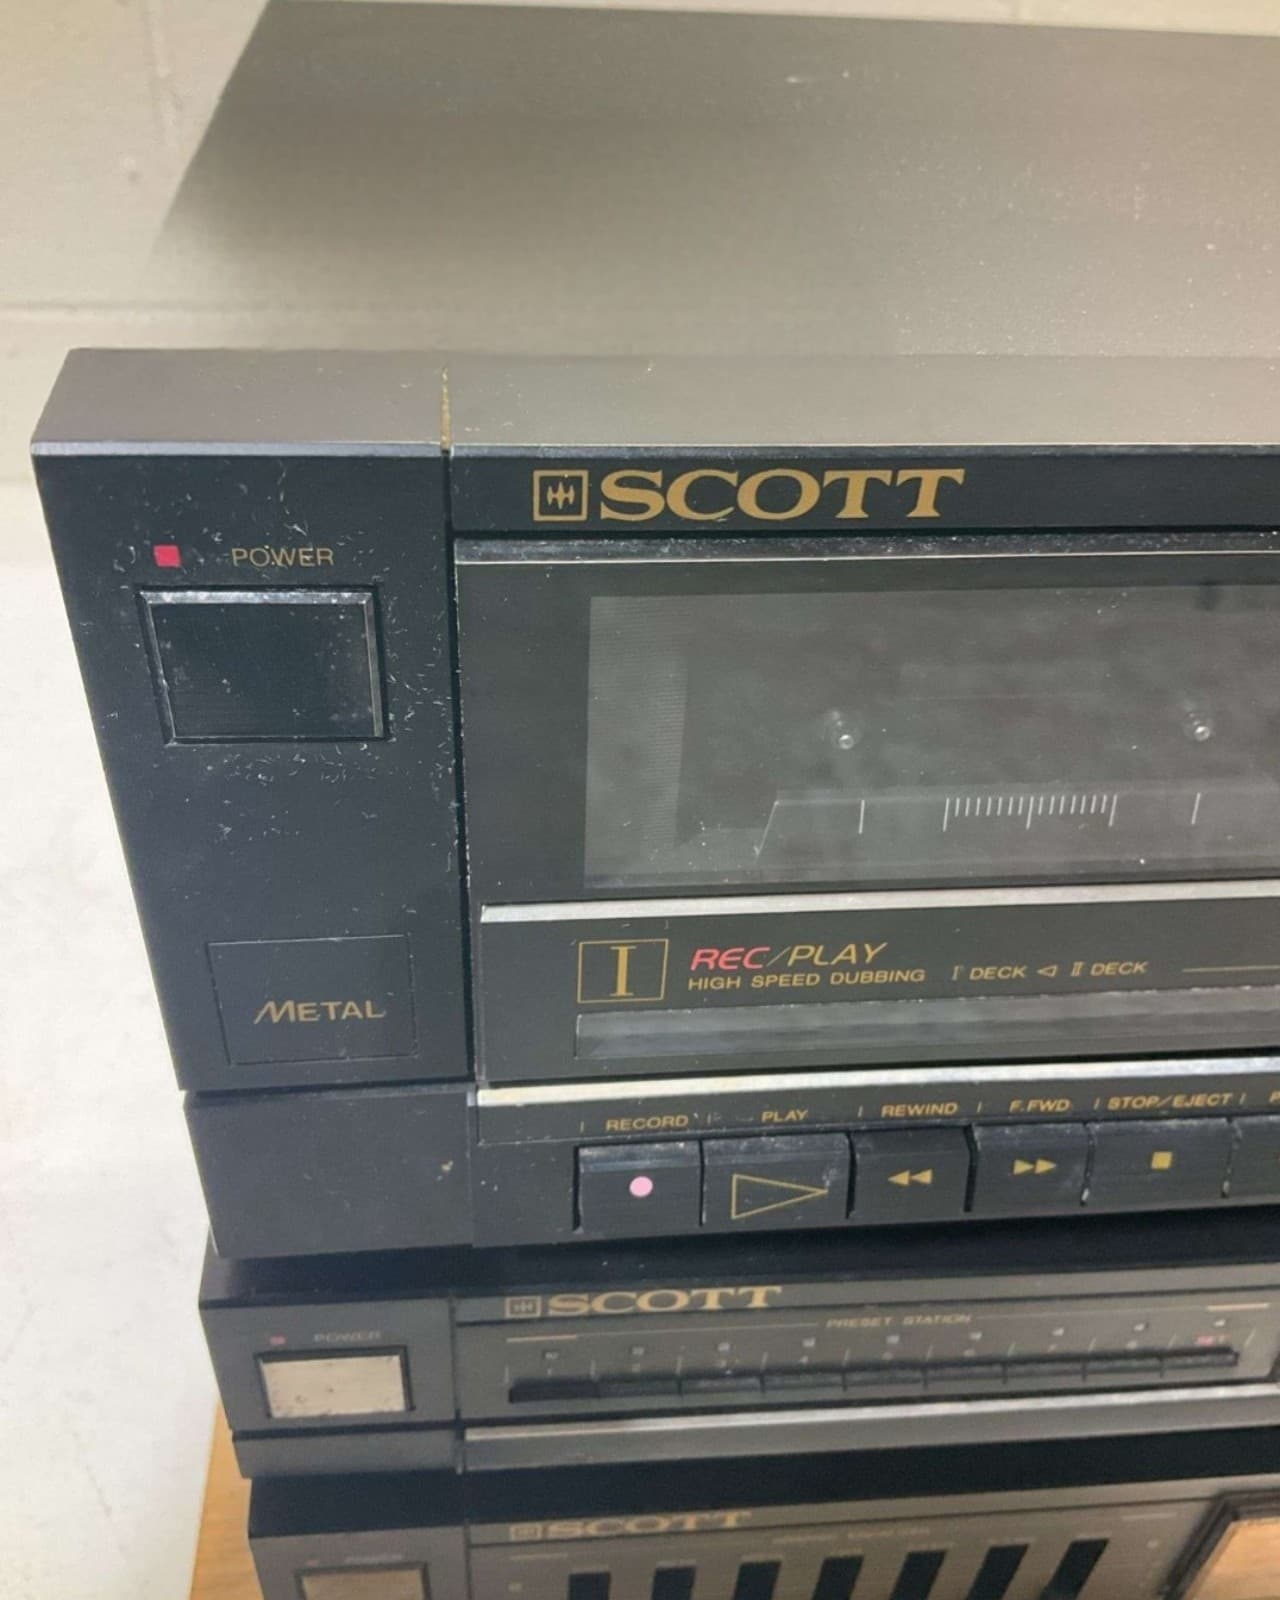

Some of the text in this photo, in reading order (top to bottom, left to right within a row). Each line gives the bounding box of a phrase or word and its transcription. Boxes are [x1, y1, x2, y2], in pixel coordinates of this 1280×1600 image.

[600, 468, 966, 521] SCOTT
[231, 546, 335, 567] POWER
[690, 941, 889, 972] REC/PLAY
[688, 968, 927, 991] HIGH SPEED DUBBING
[969, 964, 1028, 981] DECK
[1090, 960, 1148, 977] DECK
[253, 999, 388, 1025] METAL
[881, 1101, 959, 1118] REWIND
[1009, 1098, 1072, 1114] F.FWD
[1107, 1092, 1233, 1111] STOP/EJECT
[606, 1113, 690, 1132] RECORD
[761, 1108, 809, 1123] PLAY
[548, 1285, 783, 1316] SCOTT
[827, 1312, 973, 1329] PRESET STATION
[547, 1510, 752, 1541] SCOTT
